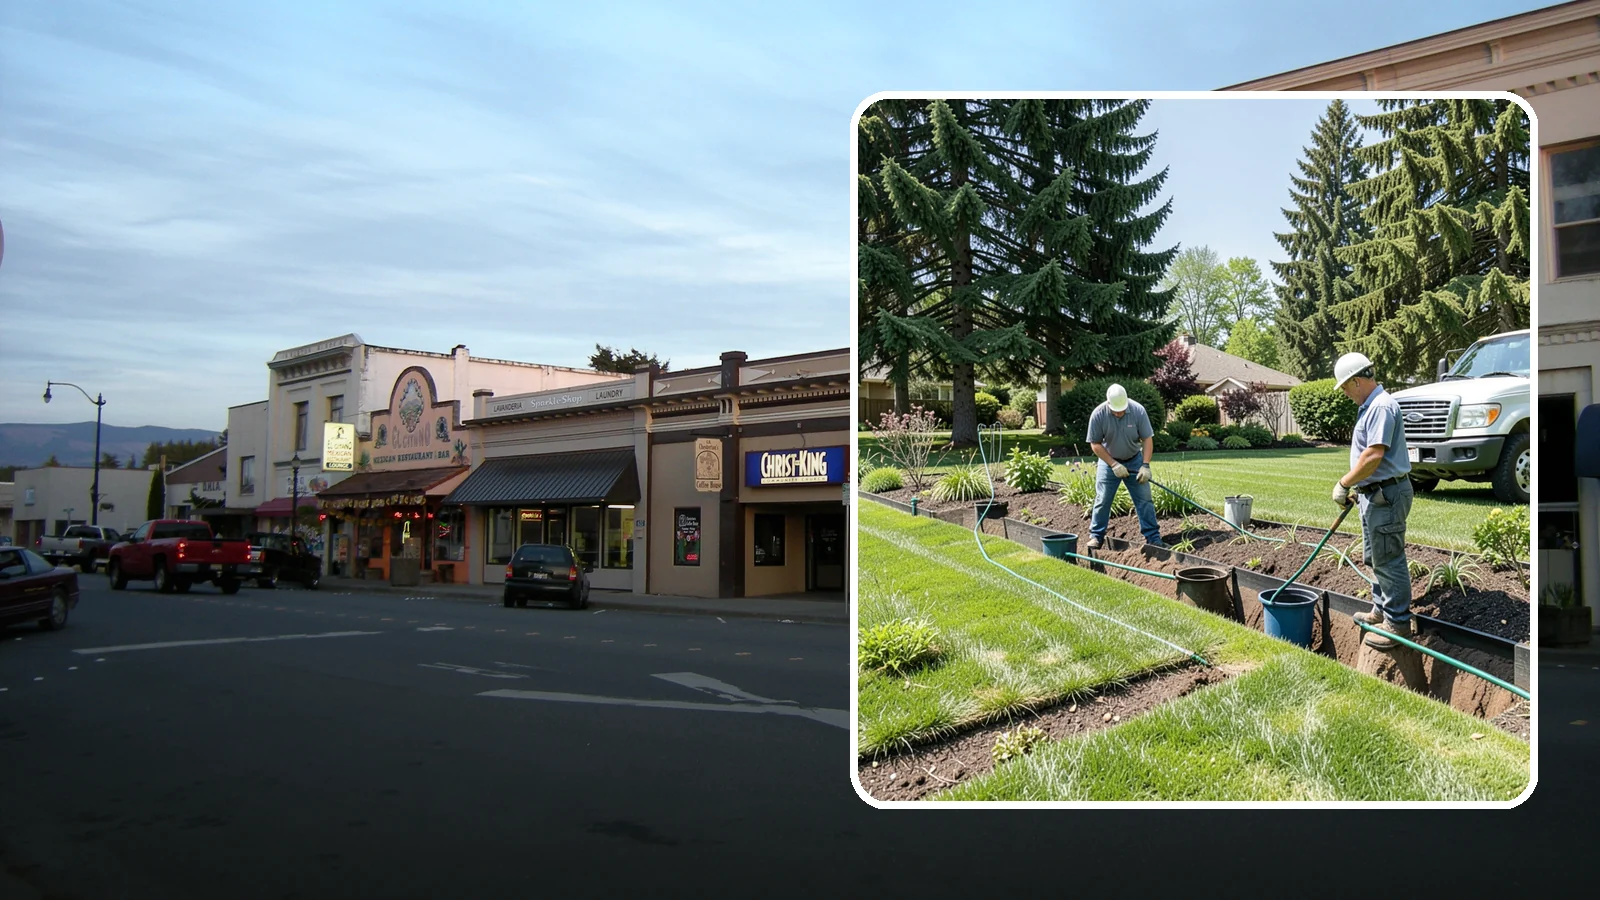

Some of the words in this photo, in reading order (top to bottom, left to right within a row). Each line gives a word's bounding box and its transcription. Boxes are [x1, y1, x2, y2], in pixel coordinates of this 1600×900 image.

[595, 389, 624, 400] LAUNDRY
[493, 402, 523, 413] LAVANDERIA
[397, 451, 433, 462] RESTAURANT
[437, 450, 450, 458] BAR
[761, 452, 797, 478] CHRIST
[799, 450, 827, 476] KING
